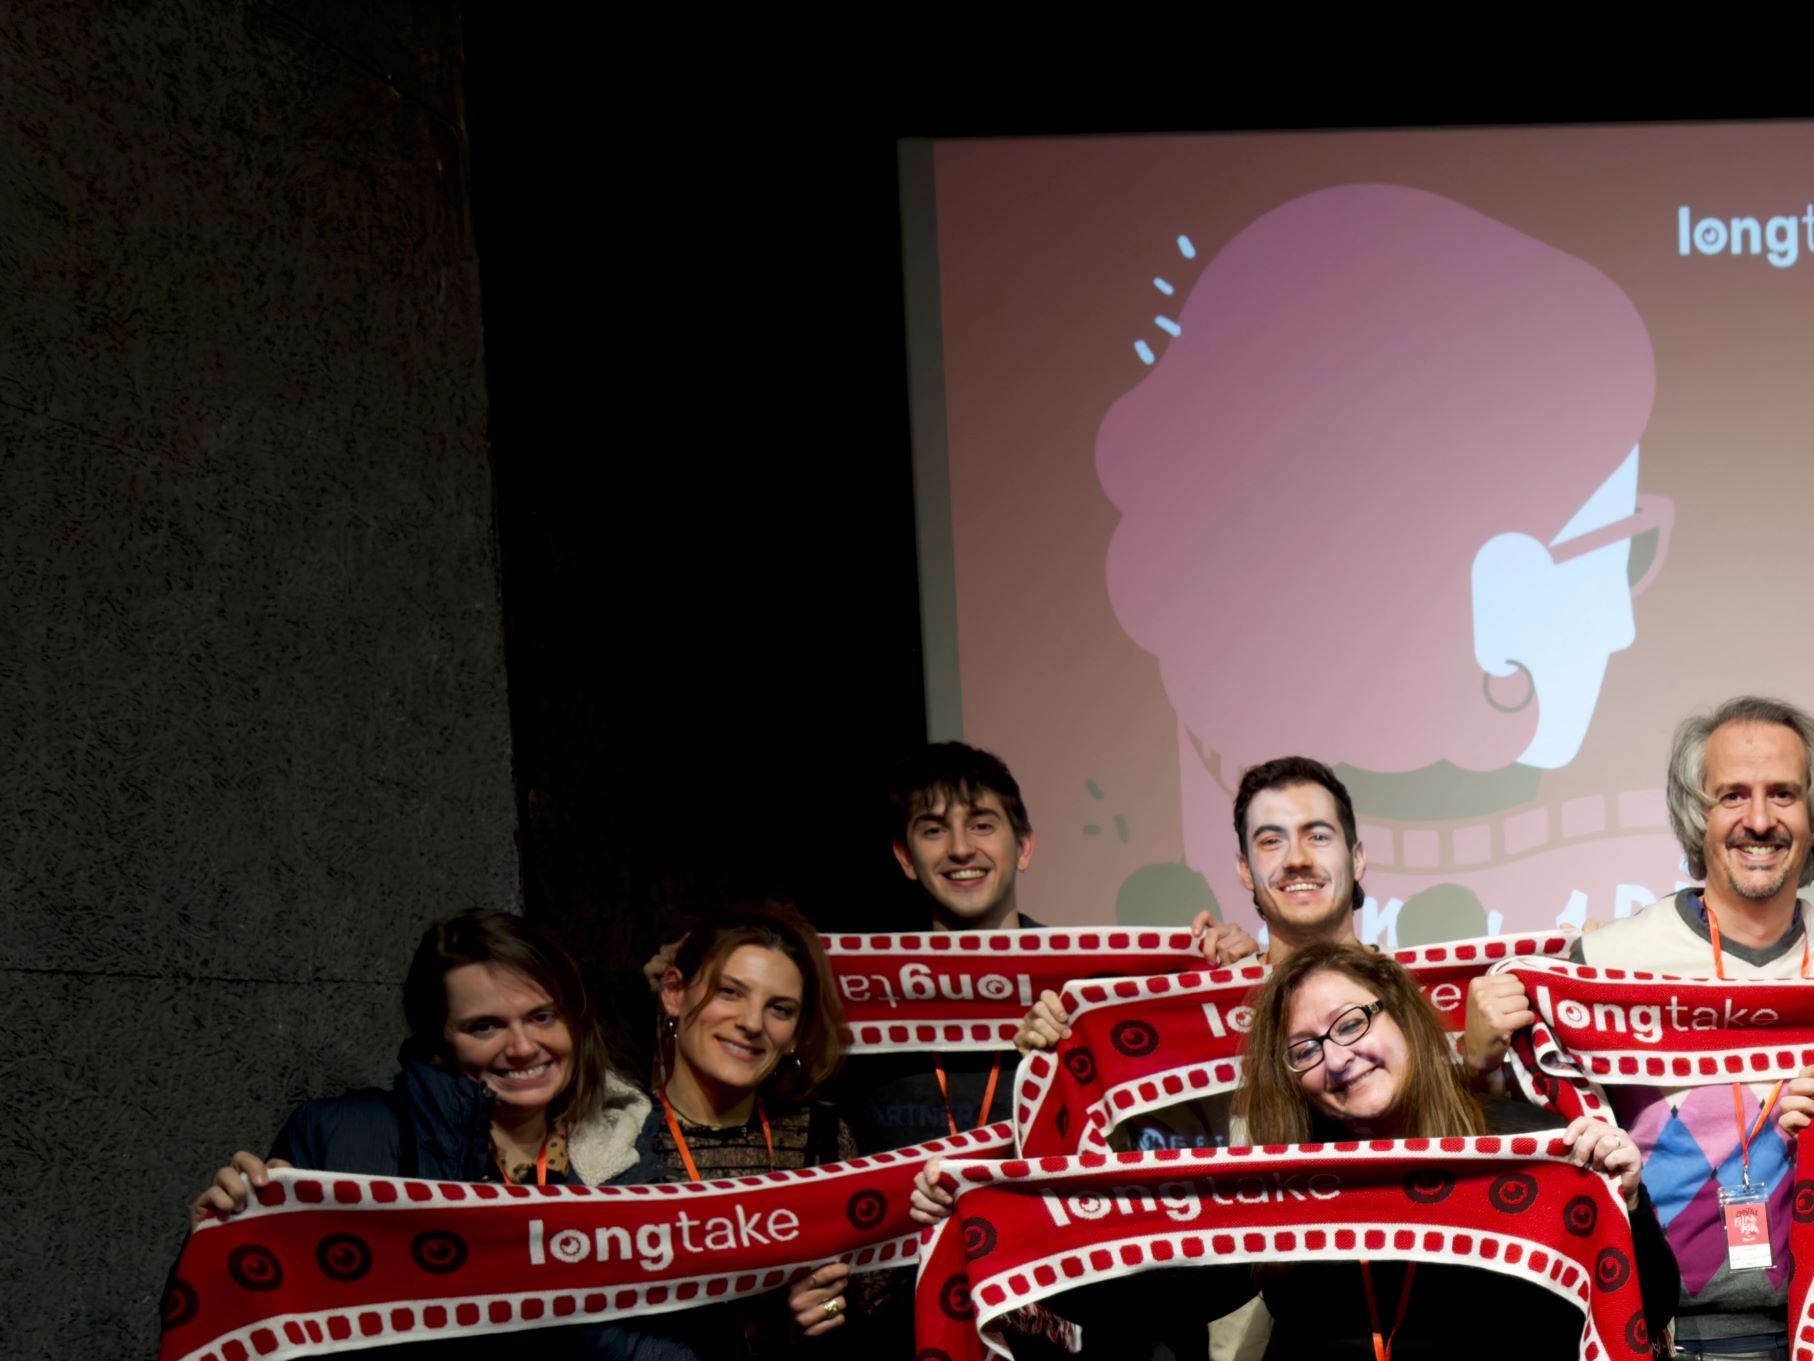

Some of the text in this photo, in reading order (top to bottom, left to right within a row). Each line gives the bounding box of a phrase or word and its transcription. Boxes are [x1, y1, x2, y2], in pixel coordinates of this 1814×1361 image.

[838, 962, 1033, 1008] longta
[1536, 985, 1779, 1043] longtake
[528, 1204, 799, 1271] longtake
